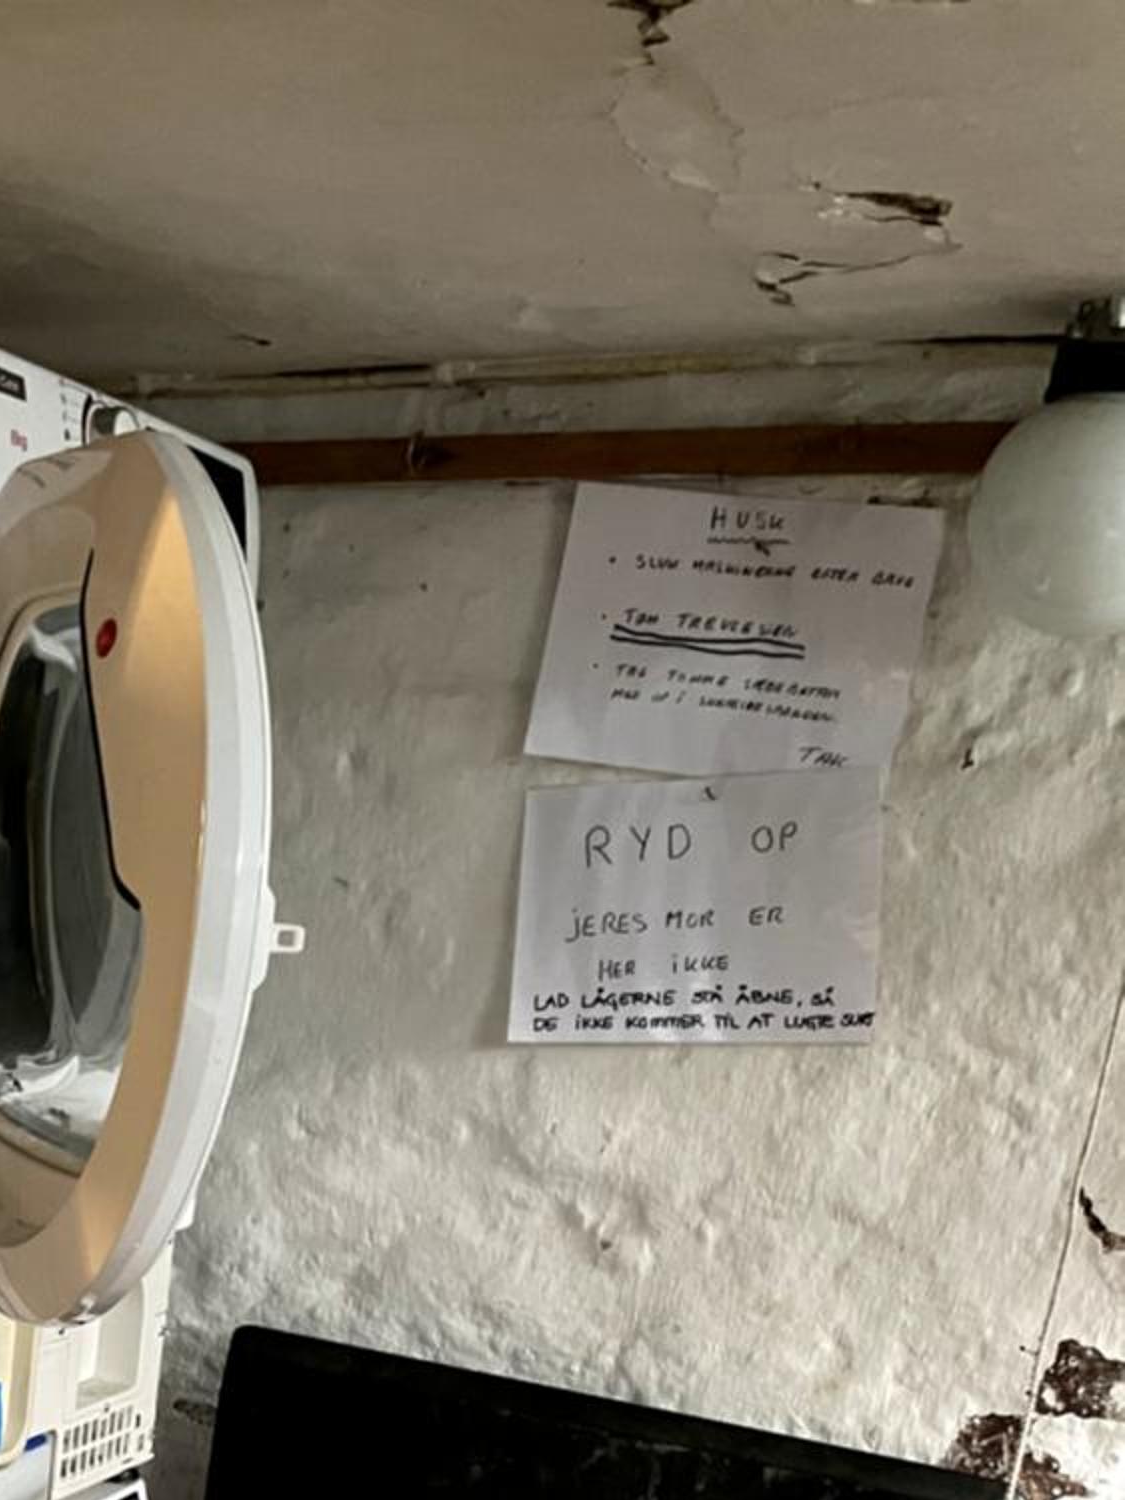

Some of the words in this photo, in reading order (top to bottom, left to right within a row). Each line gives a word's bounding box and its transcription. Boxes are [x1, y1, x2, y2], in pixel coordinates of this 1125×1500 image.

[710, 506, 785, 531] HUSK
[584, 824, 692, 869] RYD
[751, 821, 799, 854] OP
[665, 909, 715, 929] MOR
[749, 906, 783, 927] ER
[598, 959, 636, 982] HER
[534, 993, 569, 1012] LAD
[581, 988, 676, 1012] LÅGERNE
[692, 985, 723, 1005] STÅ
[810, 986, 835, 1006] SÅ
[533, 1017, 558, 1032] DE
[625, 1014, 705, 1031] KOMMER
[714, 1014, 739, 1031] TIL
[747, 1013, 774, 1030] AT
